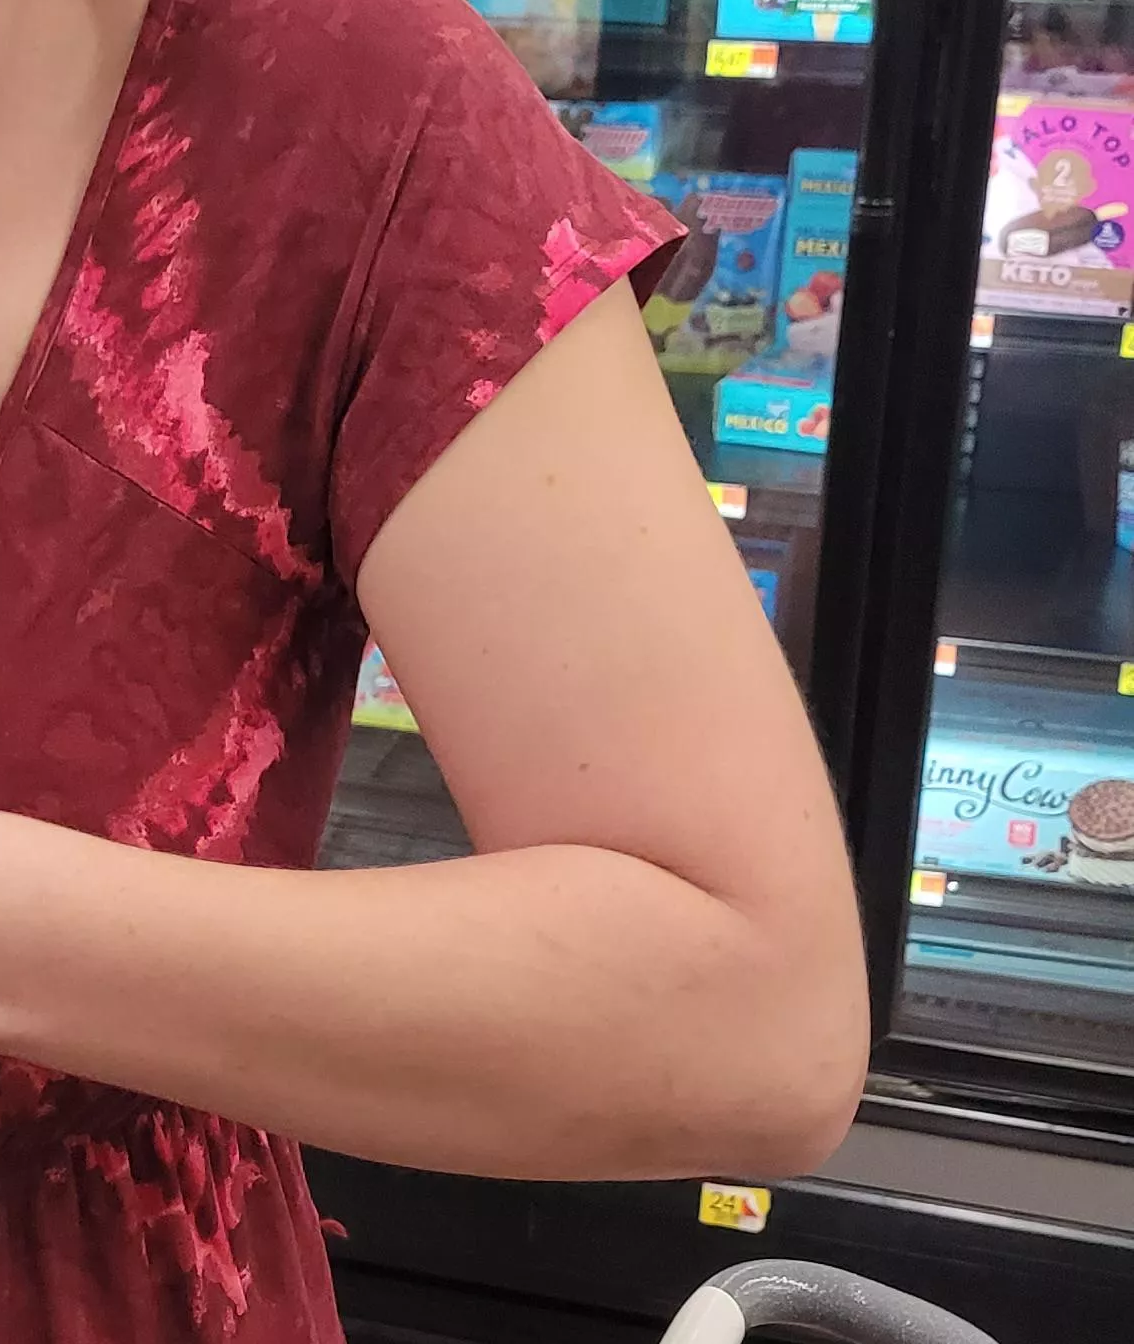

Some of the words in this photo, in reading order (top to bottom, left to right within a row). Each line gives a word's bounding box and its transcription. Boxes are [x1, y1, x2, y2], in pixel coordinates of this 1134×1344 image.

[1092, 121, 1130, 167] TOP
[1055, 159, 1071, 187] 2
[1001, 260, 1071, 286] KETO
[1001, 759, 1068, 810] Cow
